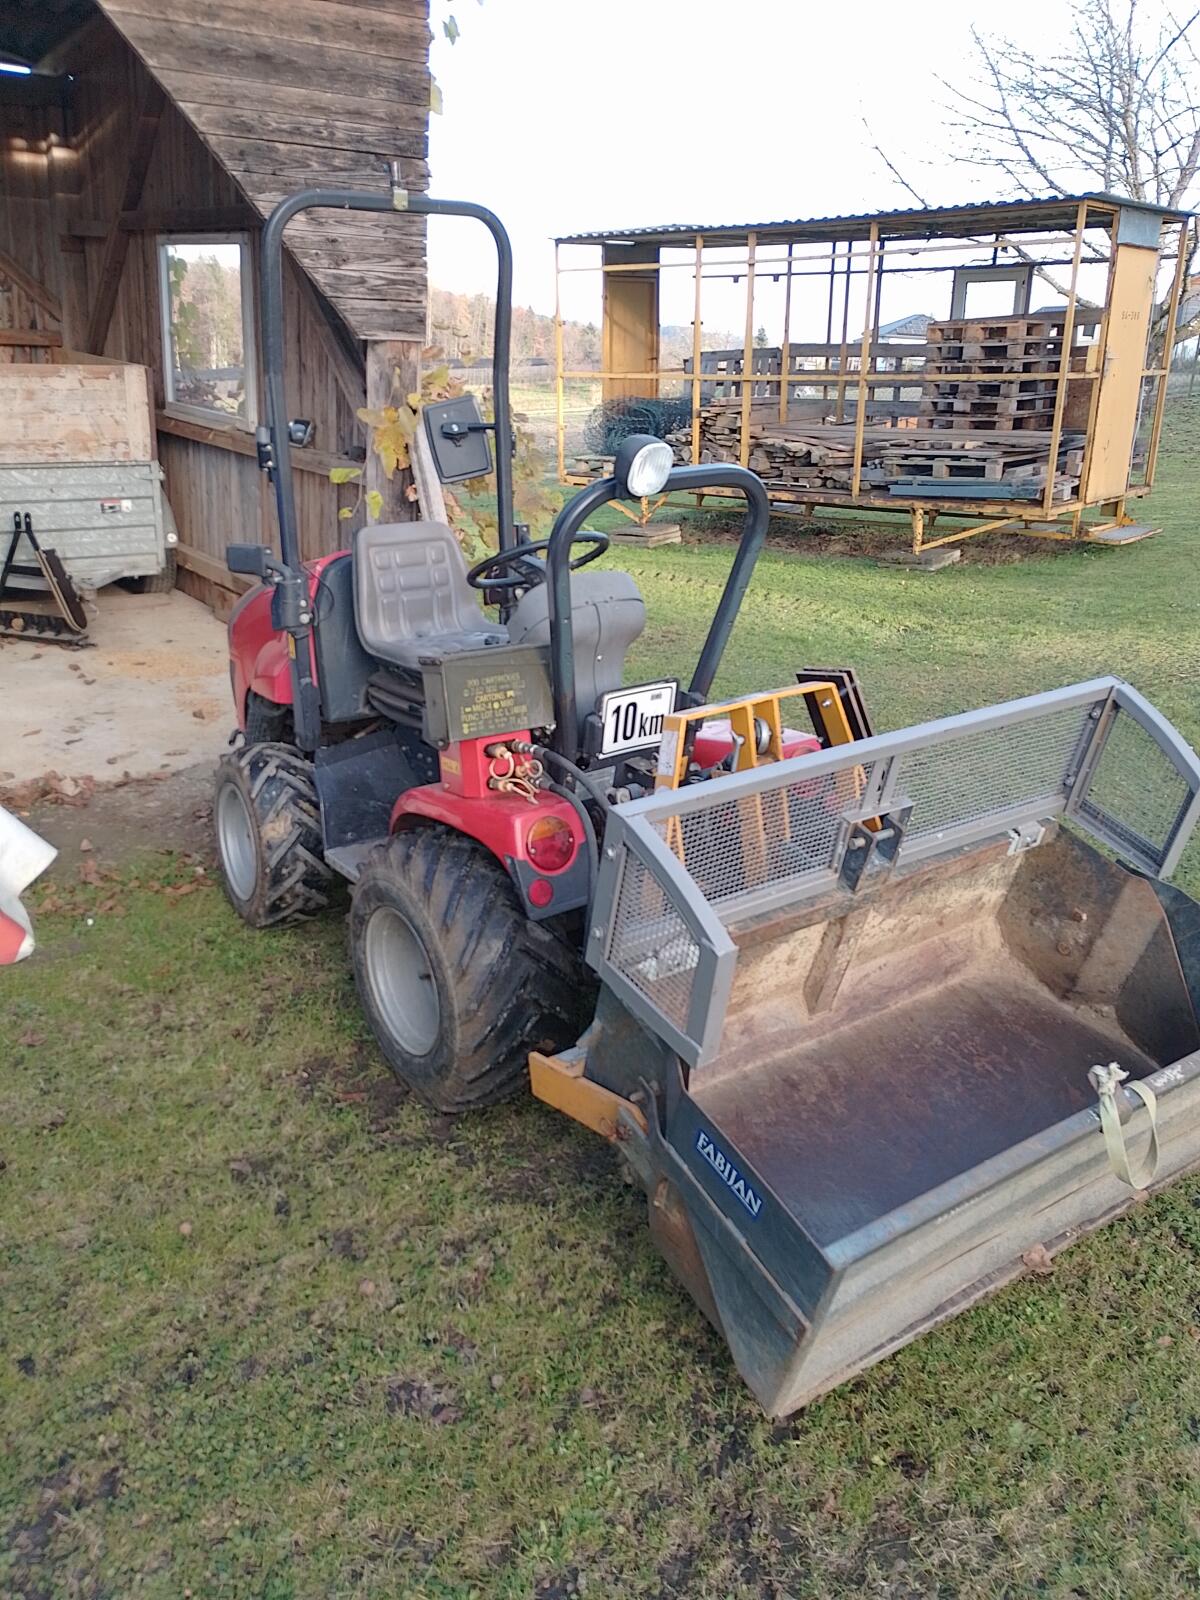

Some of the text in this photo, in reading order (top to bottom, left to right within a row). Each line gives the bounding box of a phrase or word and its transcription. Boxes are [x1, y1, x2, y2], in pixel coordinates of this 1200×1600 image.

[612, 702, 664, 743] 10 km
[696, 1131, 762, 1214] FABIJAN
